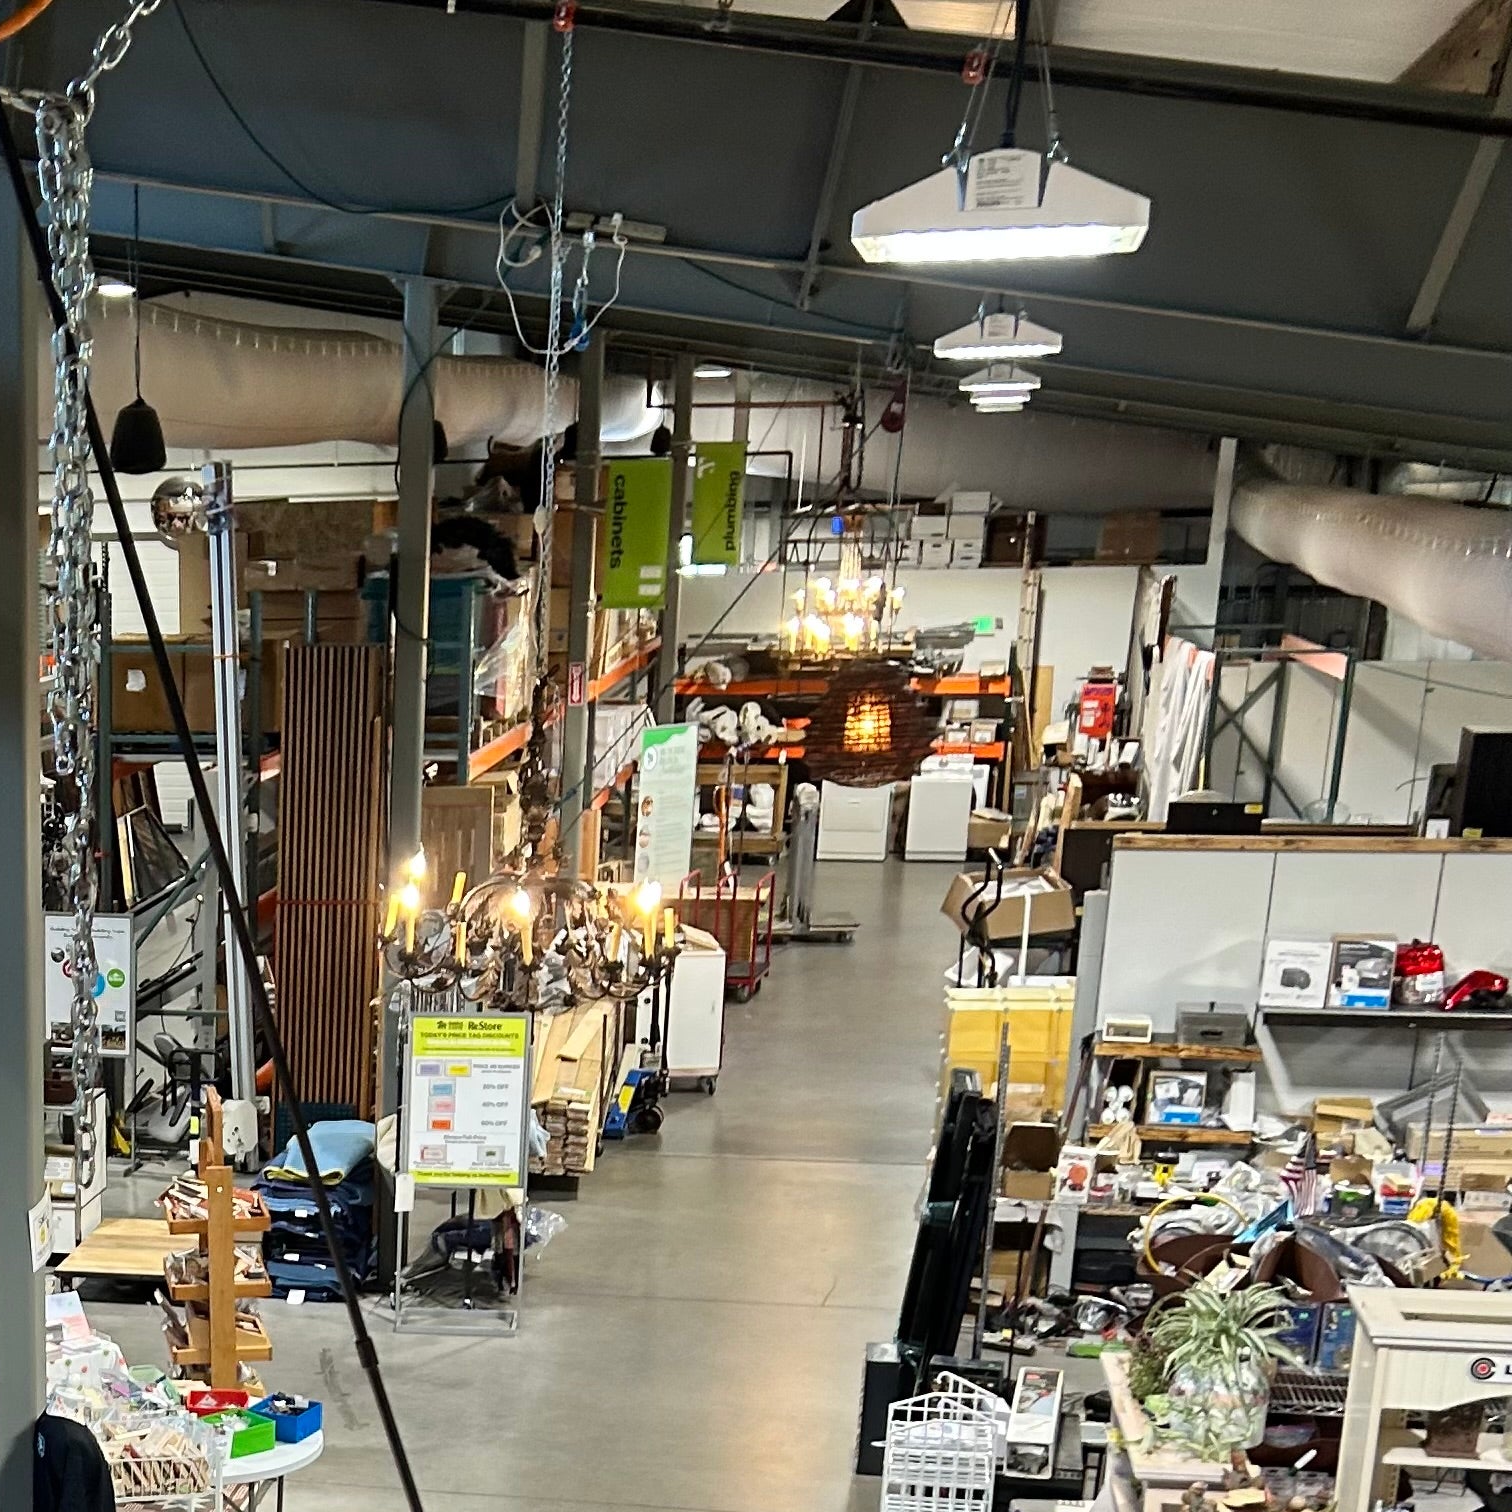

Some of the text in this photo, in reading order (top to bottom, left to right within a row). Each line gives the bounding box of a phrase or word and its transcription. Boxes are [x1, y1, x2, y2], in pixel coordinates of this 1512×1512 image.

[610, 474, 627, 569] cabinets
[722, 471, 740, 552] plumbing
[468, 1021, 503, 1031] ReStore
